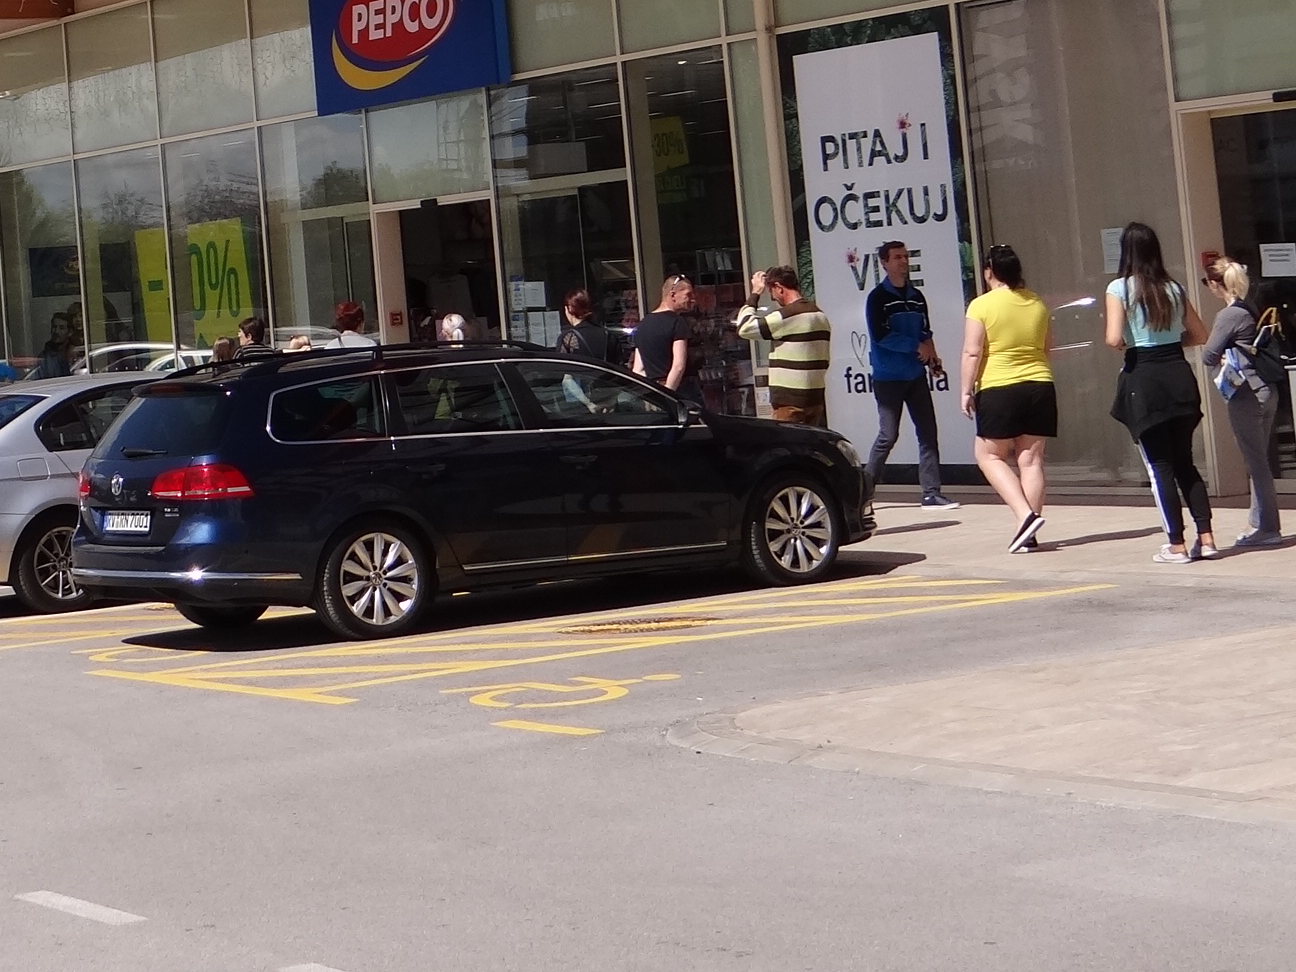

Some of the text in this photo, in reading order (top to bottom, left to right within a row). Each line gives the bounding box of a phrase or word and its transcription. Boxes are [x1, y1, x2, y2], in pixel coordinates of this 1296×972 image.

[819, 122, 930, 172] PITAJ I
[813, 182, 949, 233] OČEKUJ
[849, 246, 925, 291] VIE
